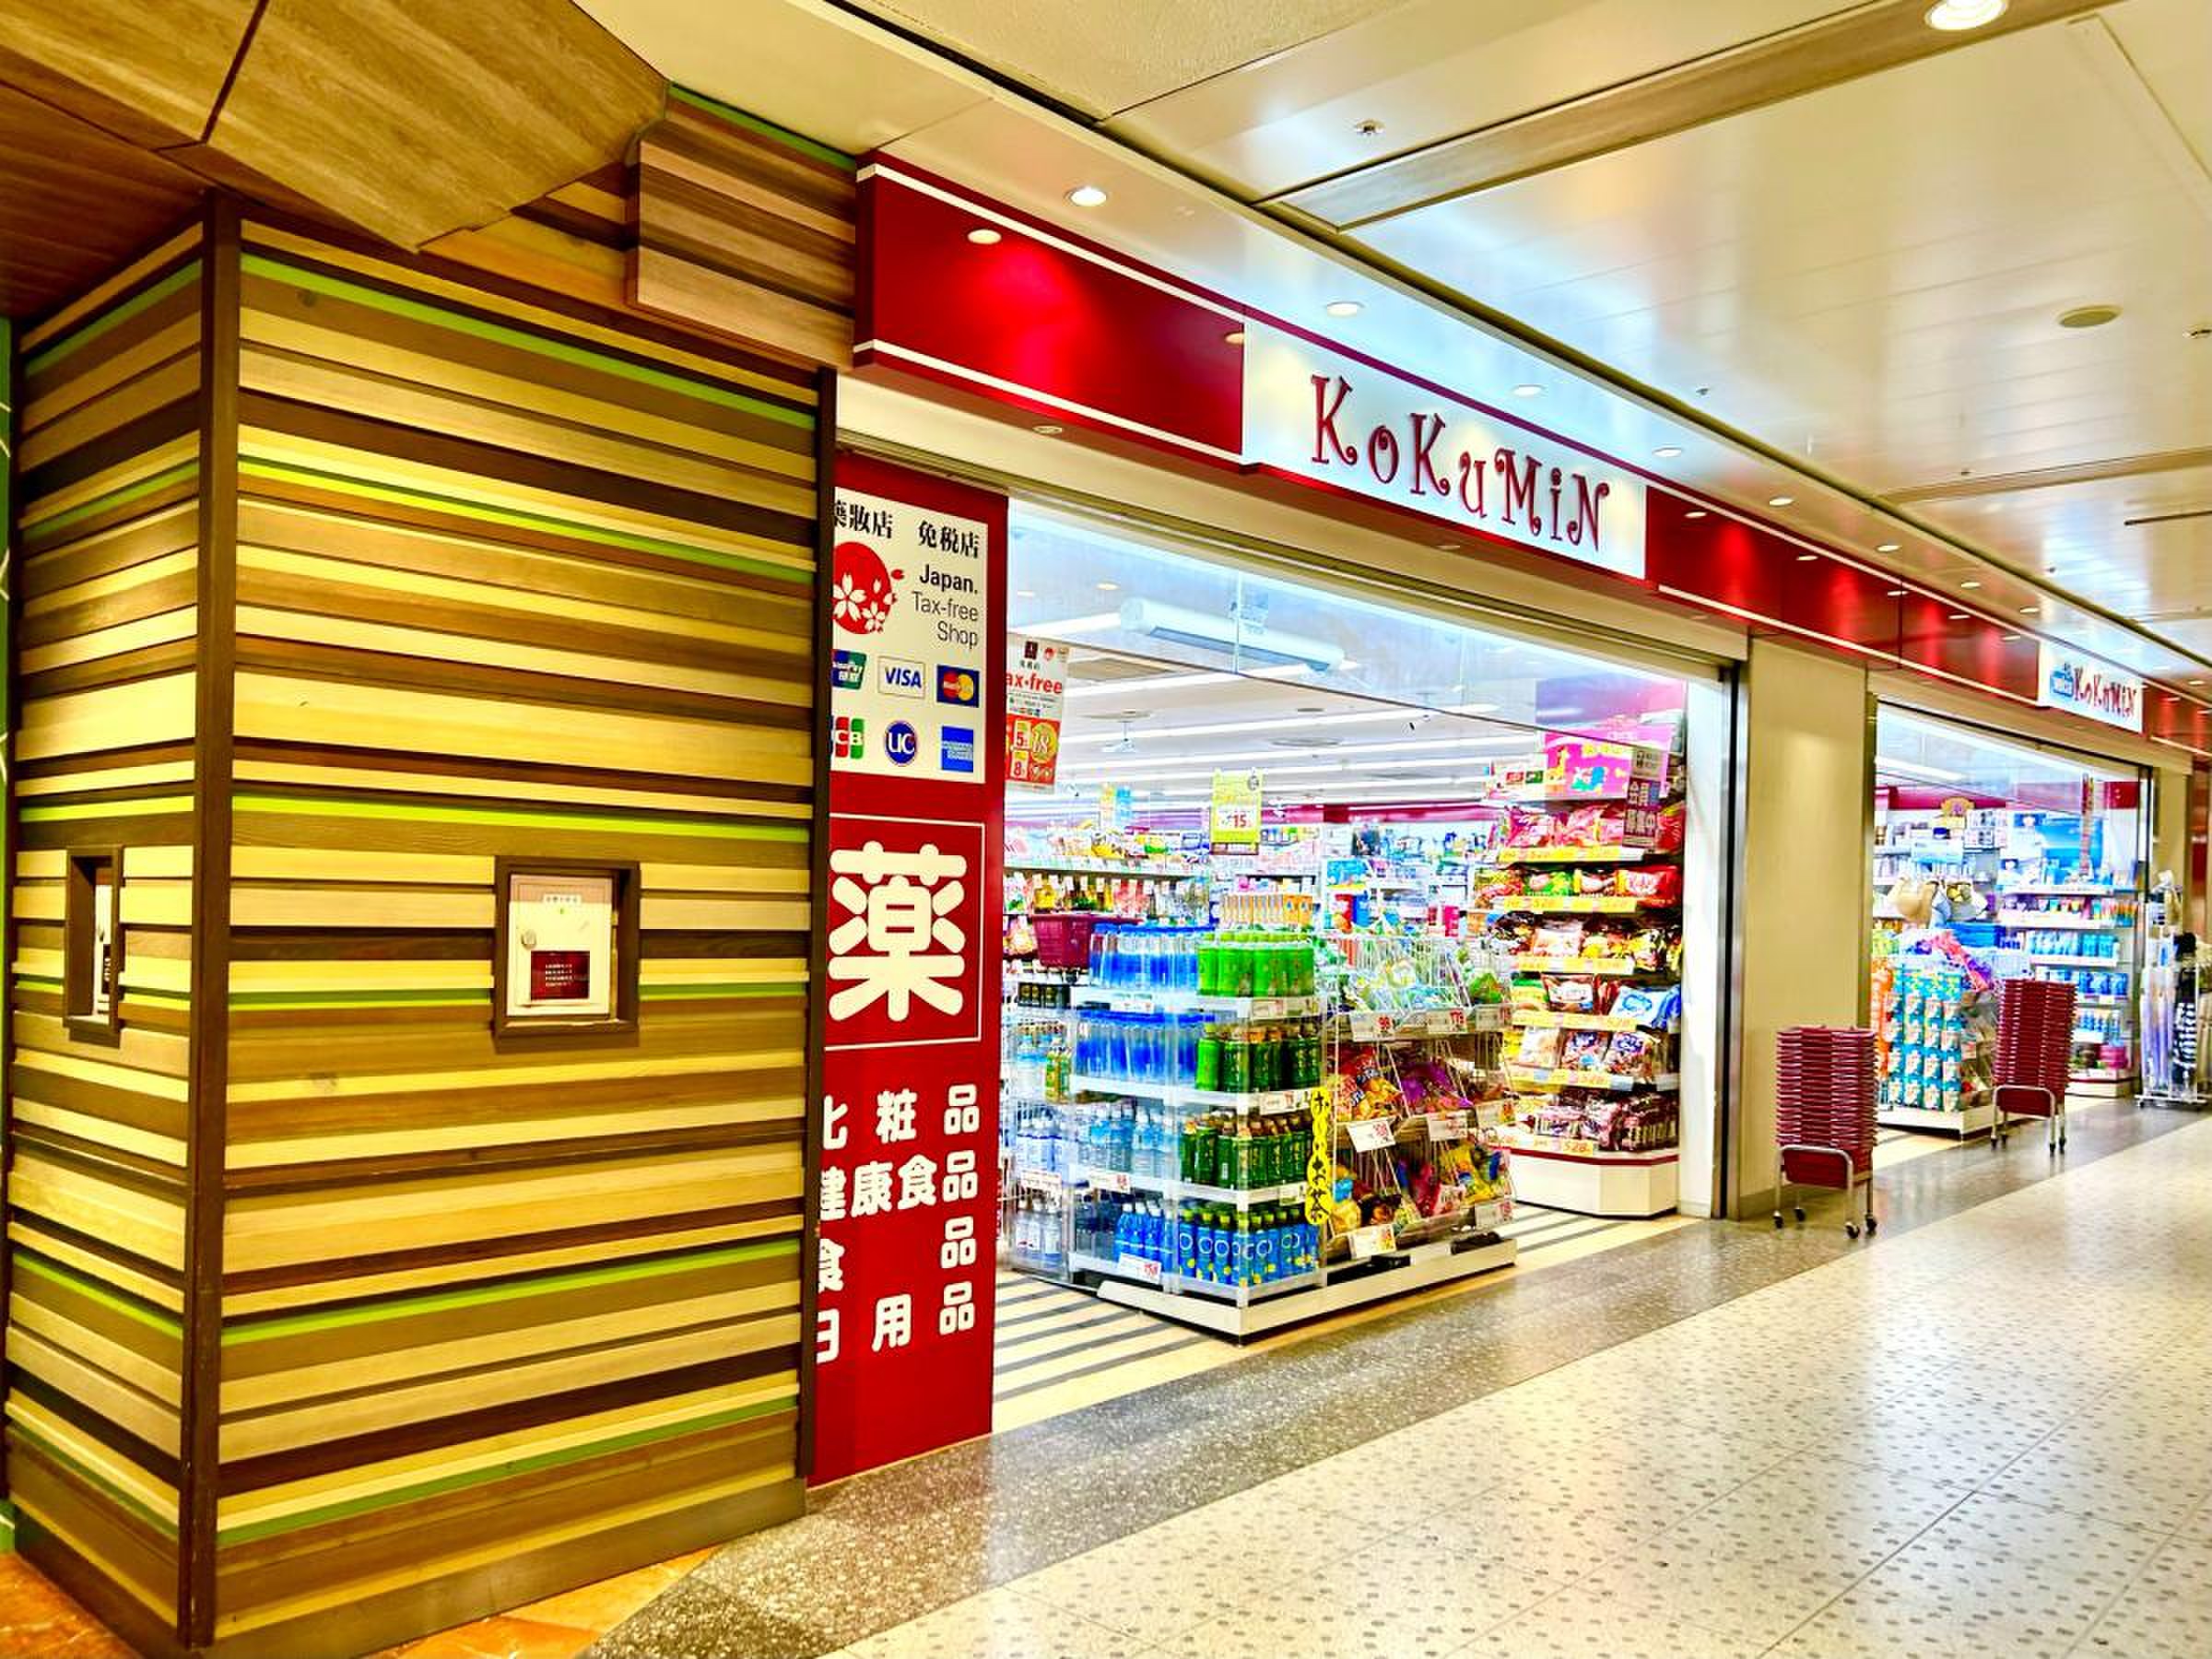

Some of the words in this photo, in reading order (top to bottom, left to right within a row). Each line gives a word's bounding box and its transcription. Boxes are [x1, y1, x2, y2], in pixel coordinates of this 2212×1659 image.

[919, 563, 979, 594] Japan.
[912, 591, 979, 621] Tax-free
[937, 620, 979, 650] Shop
[885, 666, 923, 688] VISA
[1006, 673, 1063, 694] ax-free
[832, 730, 864, 747] CB
[888, 733, 915, 754] UC
[828, 841, 968, 1021] 薬
